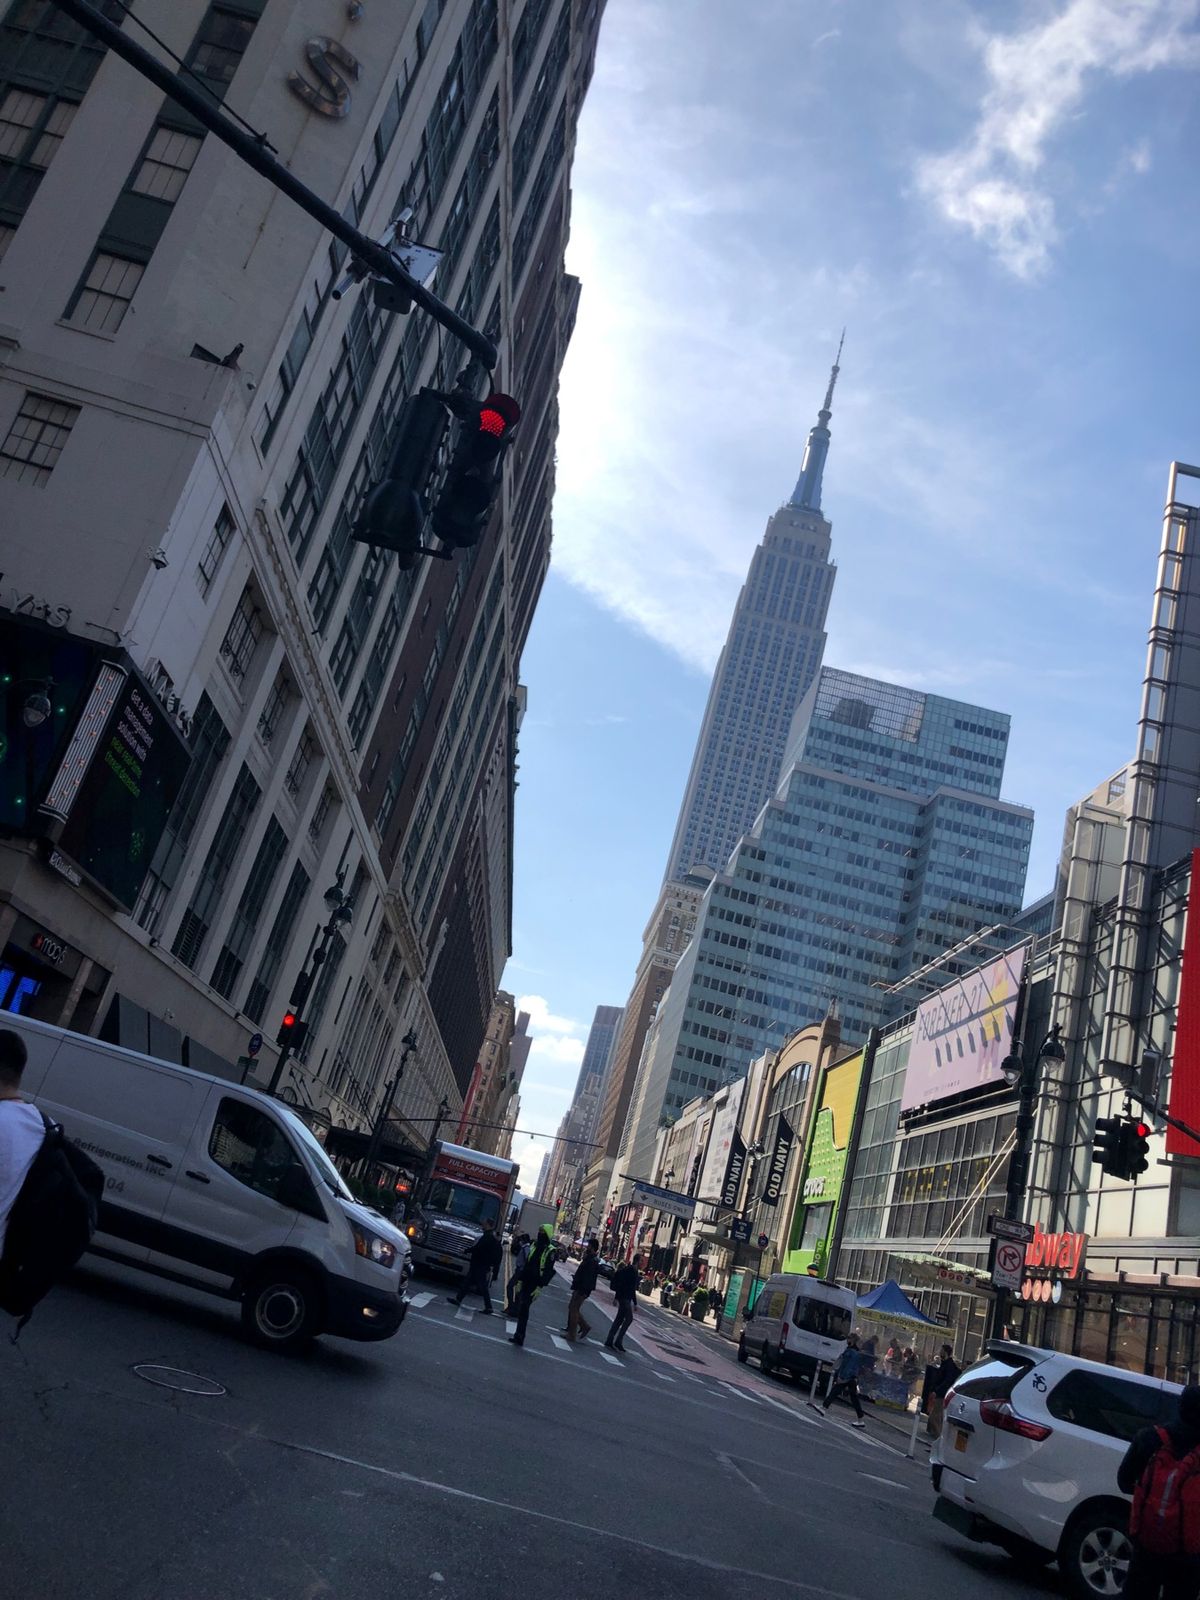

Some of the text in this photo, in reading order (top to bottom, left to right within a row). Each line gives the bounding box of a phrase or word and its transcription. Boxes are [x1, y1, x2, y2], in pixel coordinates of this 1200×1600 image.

[73, 1138, 143, 1168] Refrigeration
[448, 1159, 500, 1178] FULL CAPACITY
[768, 1137, 790, 1199] OLD NAVY
[724, 1152, 743, 1205] OLD NAVY
